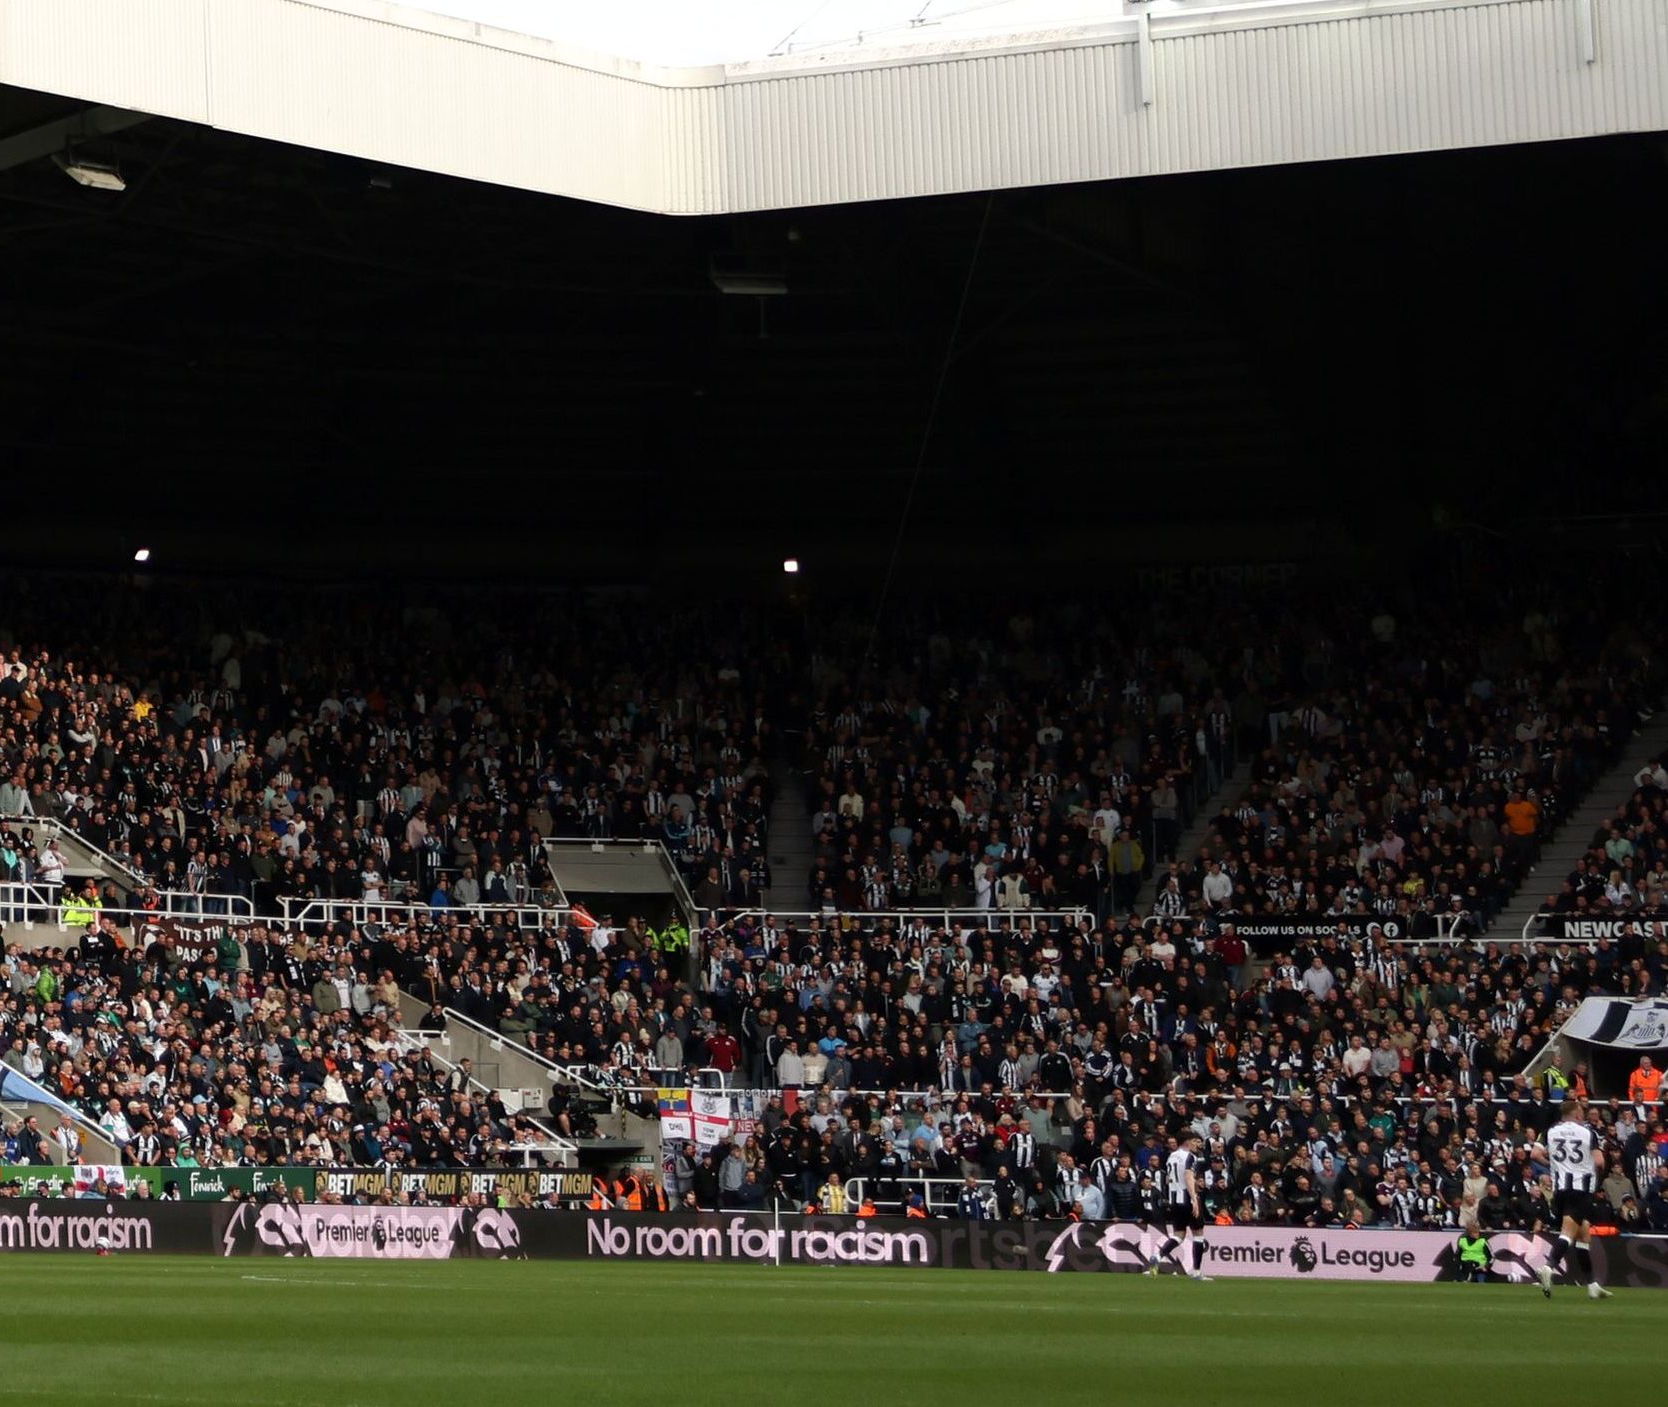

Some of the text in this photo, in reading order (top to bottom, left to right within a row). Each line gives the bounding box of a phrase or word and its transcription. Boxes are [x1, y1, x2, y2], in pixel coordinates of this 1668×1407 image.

[1236, 925, 1361, 936] FOLLOW US ON SOCLS
[1552, 1137, 1584, 1164] 33
[190, 1172, 225, 1197] Fenwick
[328, 1173, 385, 1195] BETMGM
[401, 1173, 457, 1196] BETMGM
[539, 1174, 593, 1198] BETMGM
[26, 1203, 64, 1248] for
[67, 1204, 152, 1249] racism
[316, 1219, 440, 1250] Premier League
[587, 1218, 630, 1256] No
[636, 1227, 722, 1257] room
[727, 1216, 785, 1259] for
[792, 1219, 928, 1263] racism
[1203, 1240, 1285, 1264] Premier
[1321, 1239, 1416, 1274] League
